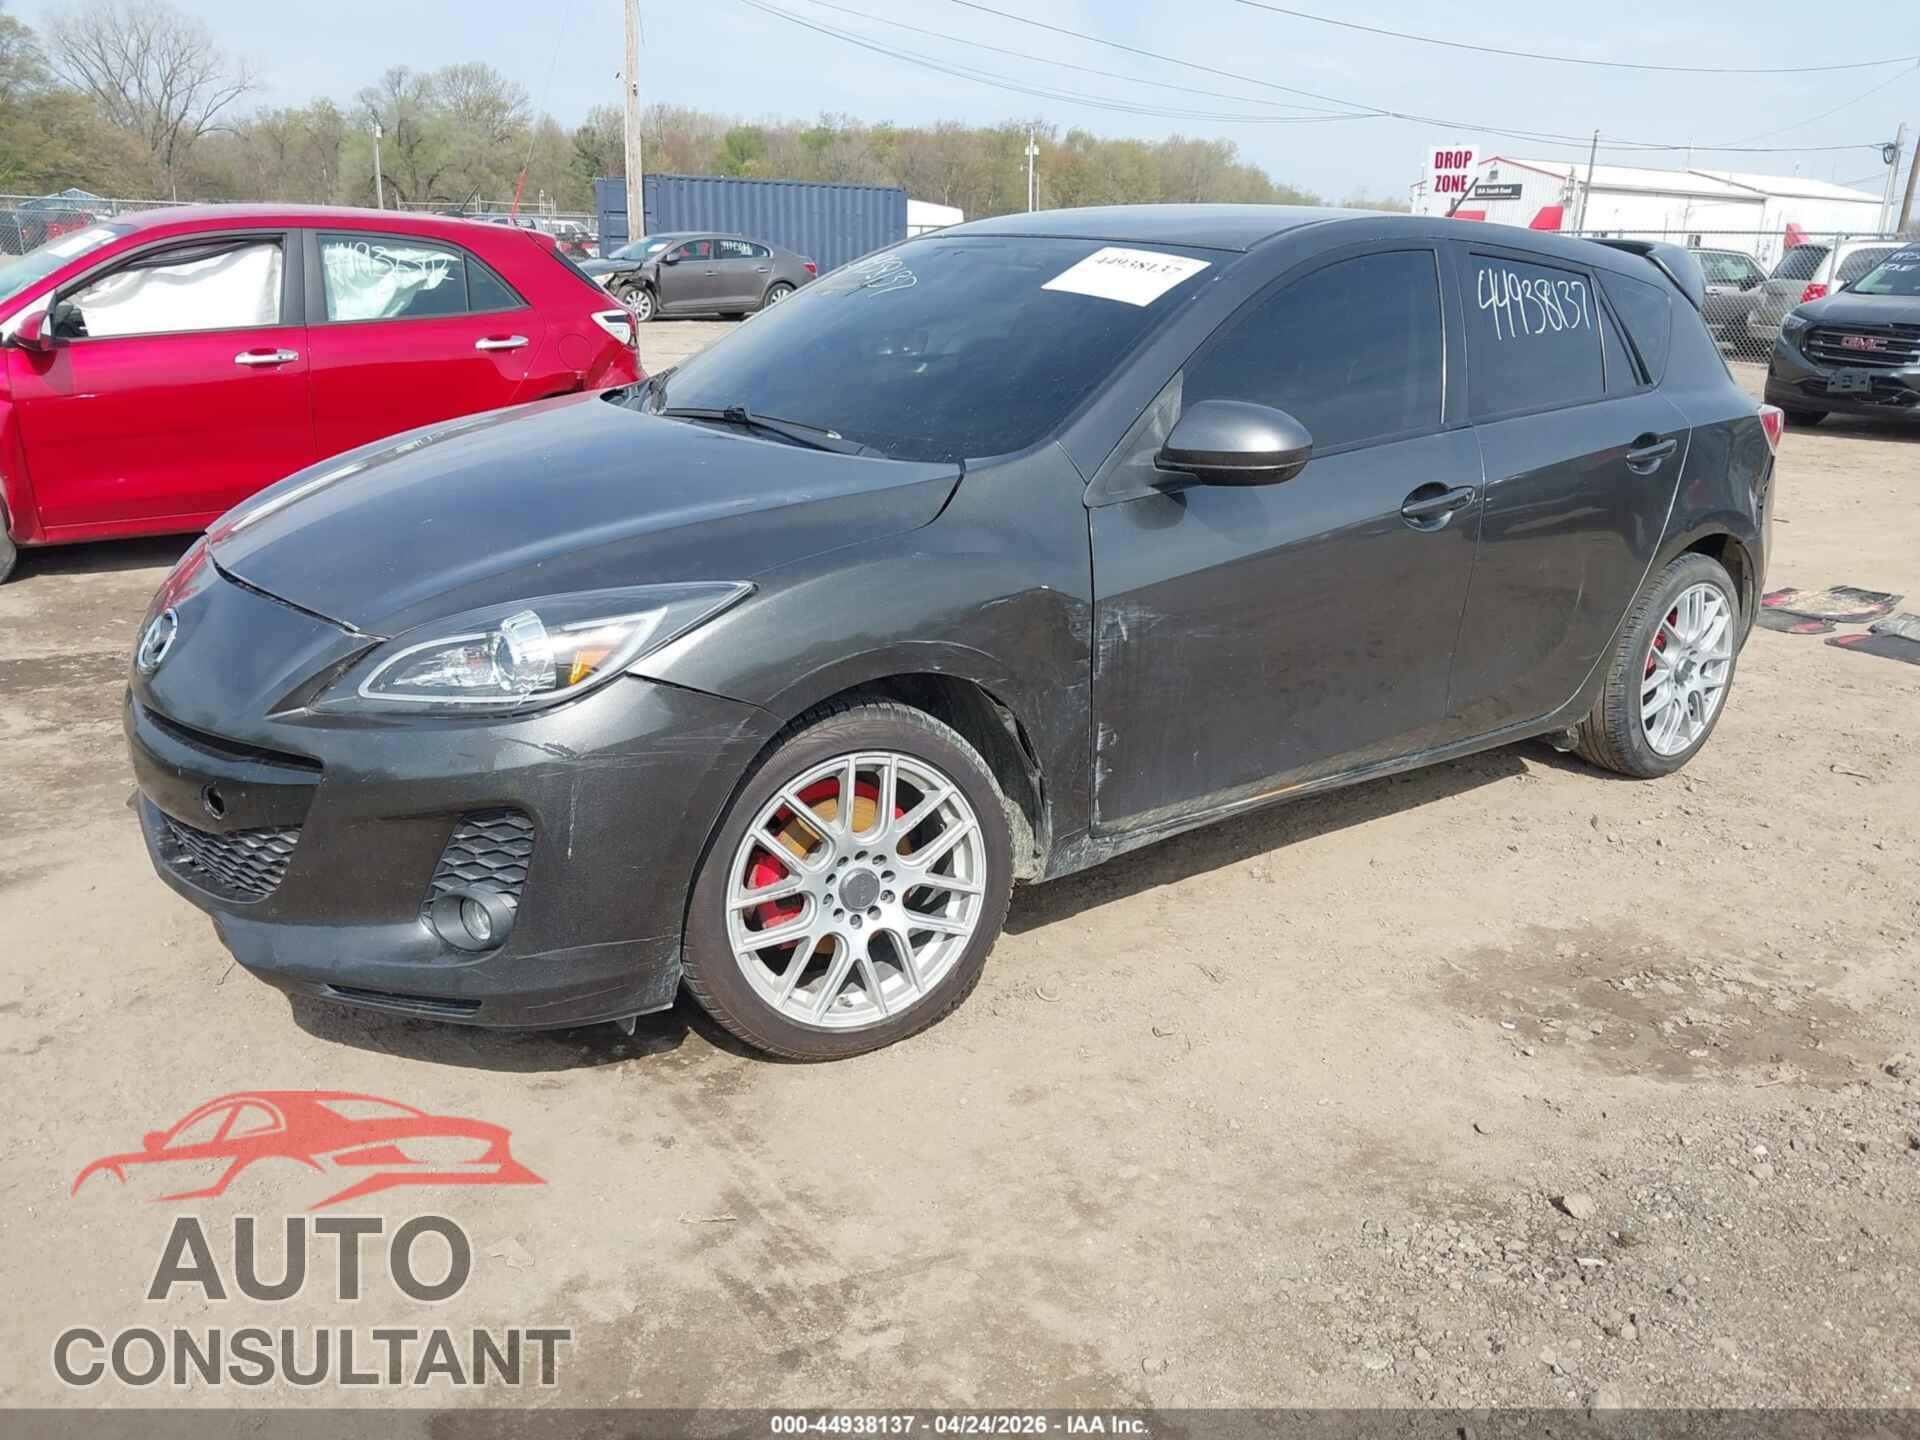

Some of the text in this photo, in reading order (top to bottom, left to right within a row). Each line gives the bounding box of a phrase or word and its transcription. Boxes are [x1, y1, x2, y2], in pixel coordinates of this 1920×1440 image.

[1434, 150, 1473, 169] DROP
[1434, 174, 1468, 193] ZONE
[1478, 268, 1590, 341] 44938137
[1840, 335, 1888, 352] GMC
